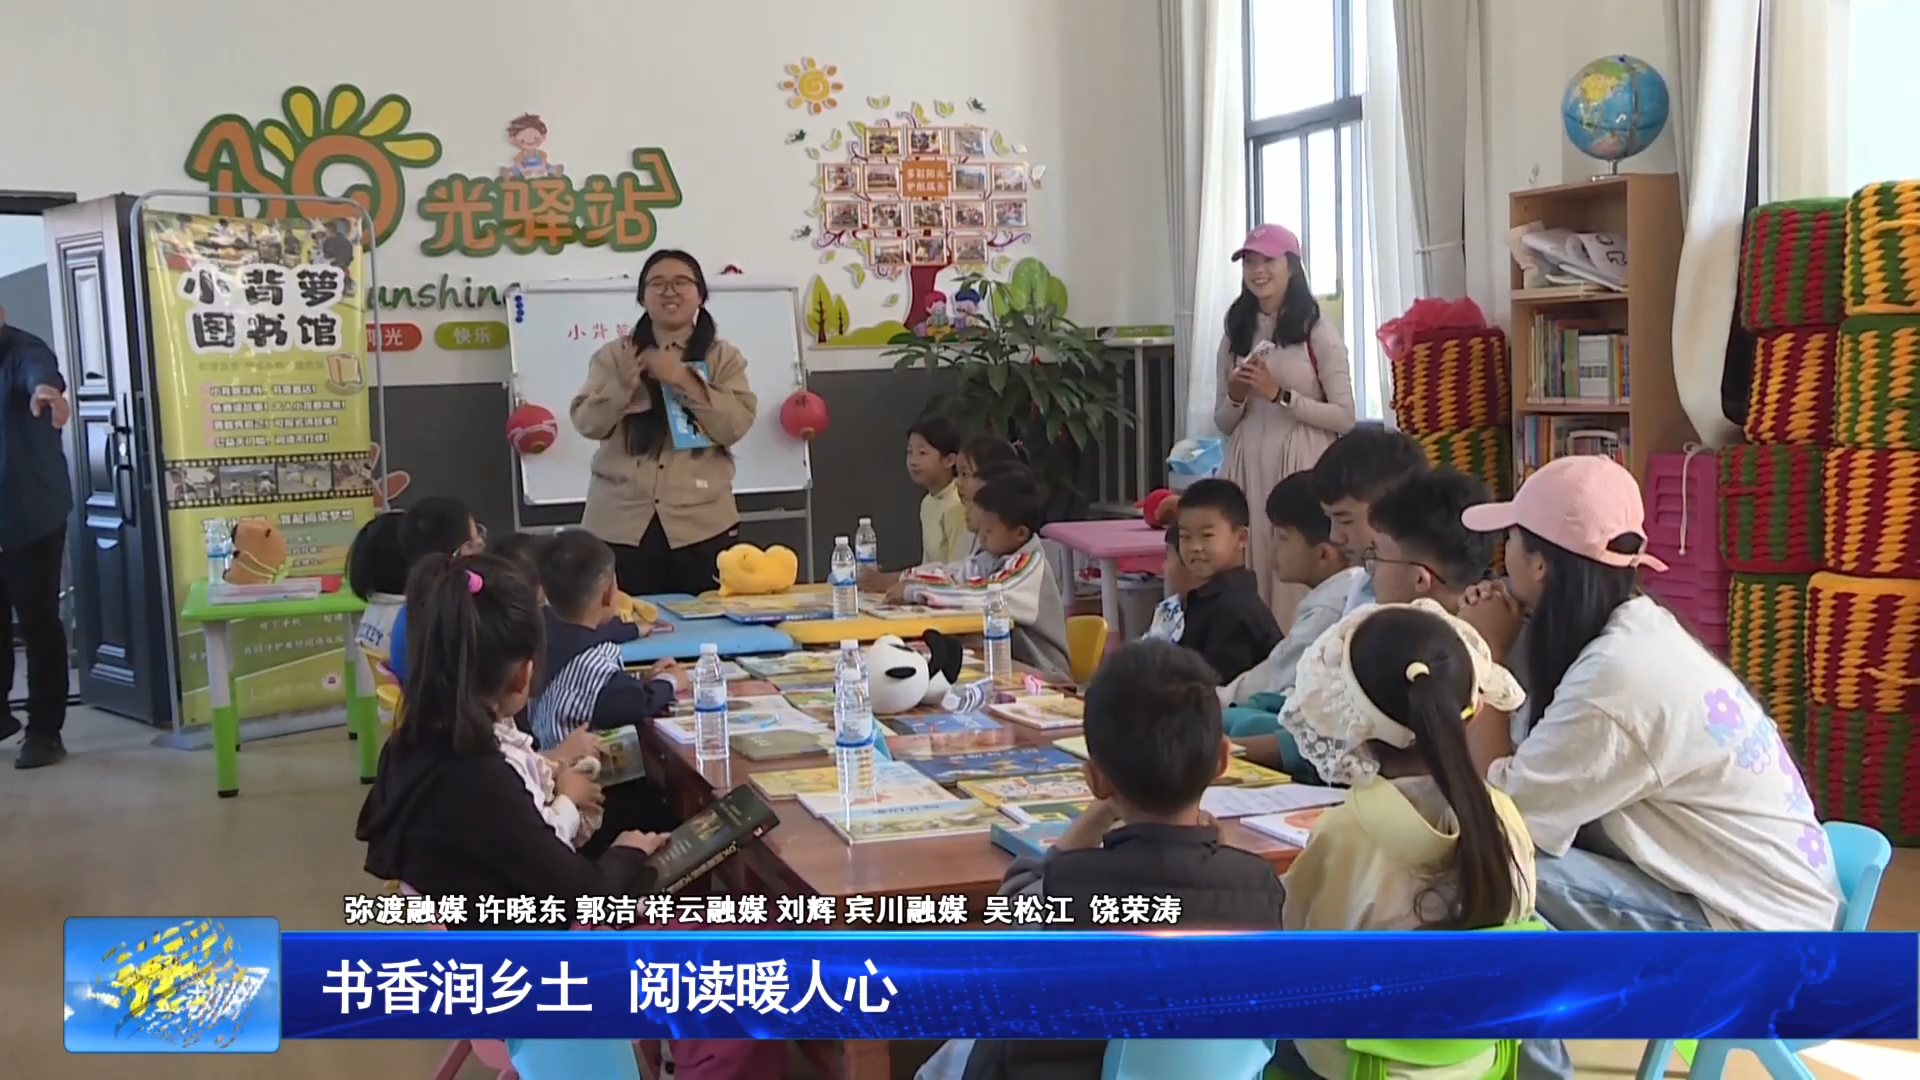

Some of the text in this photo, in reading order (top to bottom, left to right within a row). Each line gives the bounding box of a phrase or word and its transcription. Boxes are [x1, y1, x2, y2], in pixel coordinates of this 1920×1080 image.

[183, 269, 338, 306] 小背箩
[366, 273, 504, 310] unshin
[191, 311, 337, 348] 图书馆
[454, 327, 491, 345] 快乐
